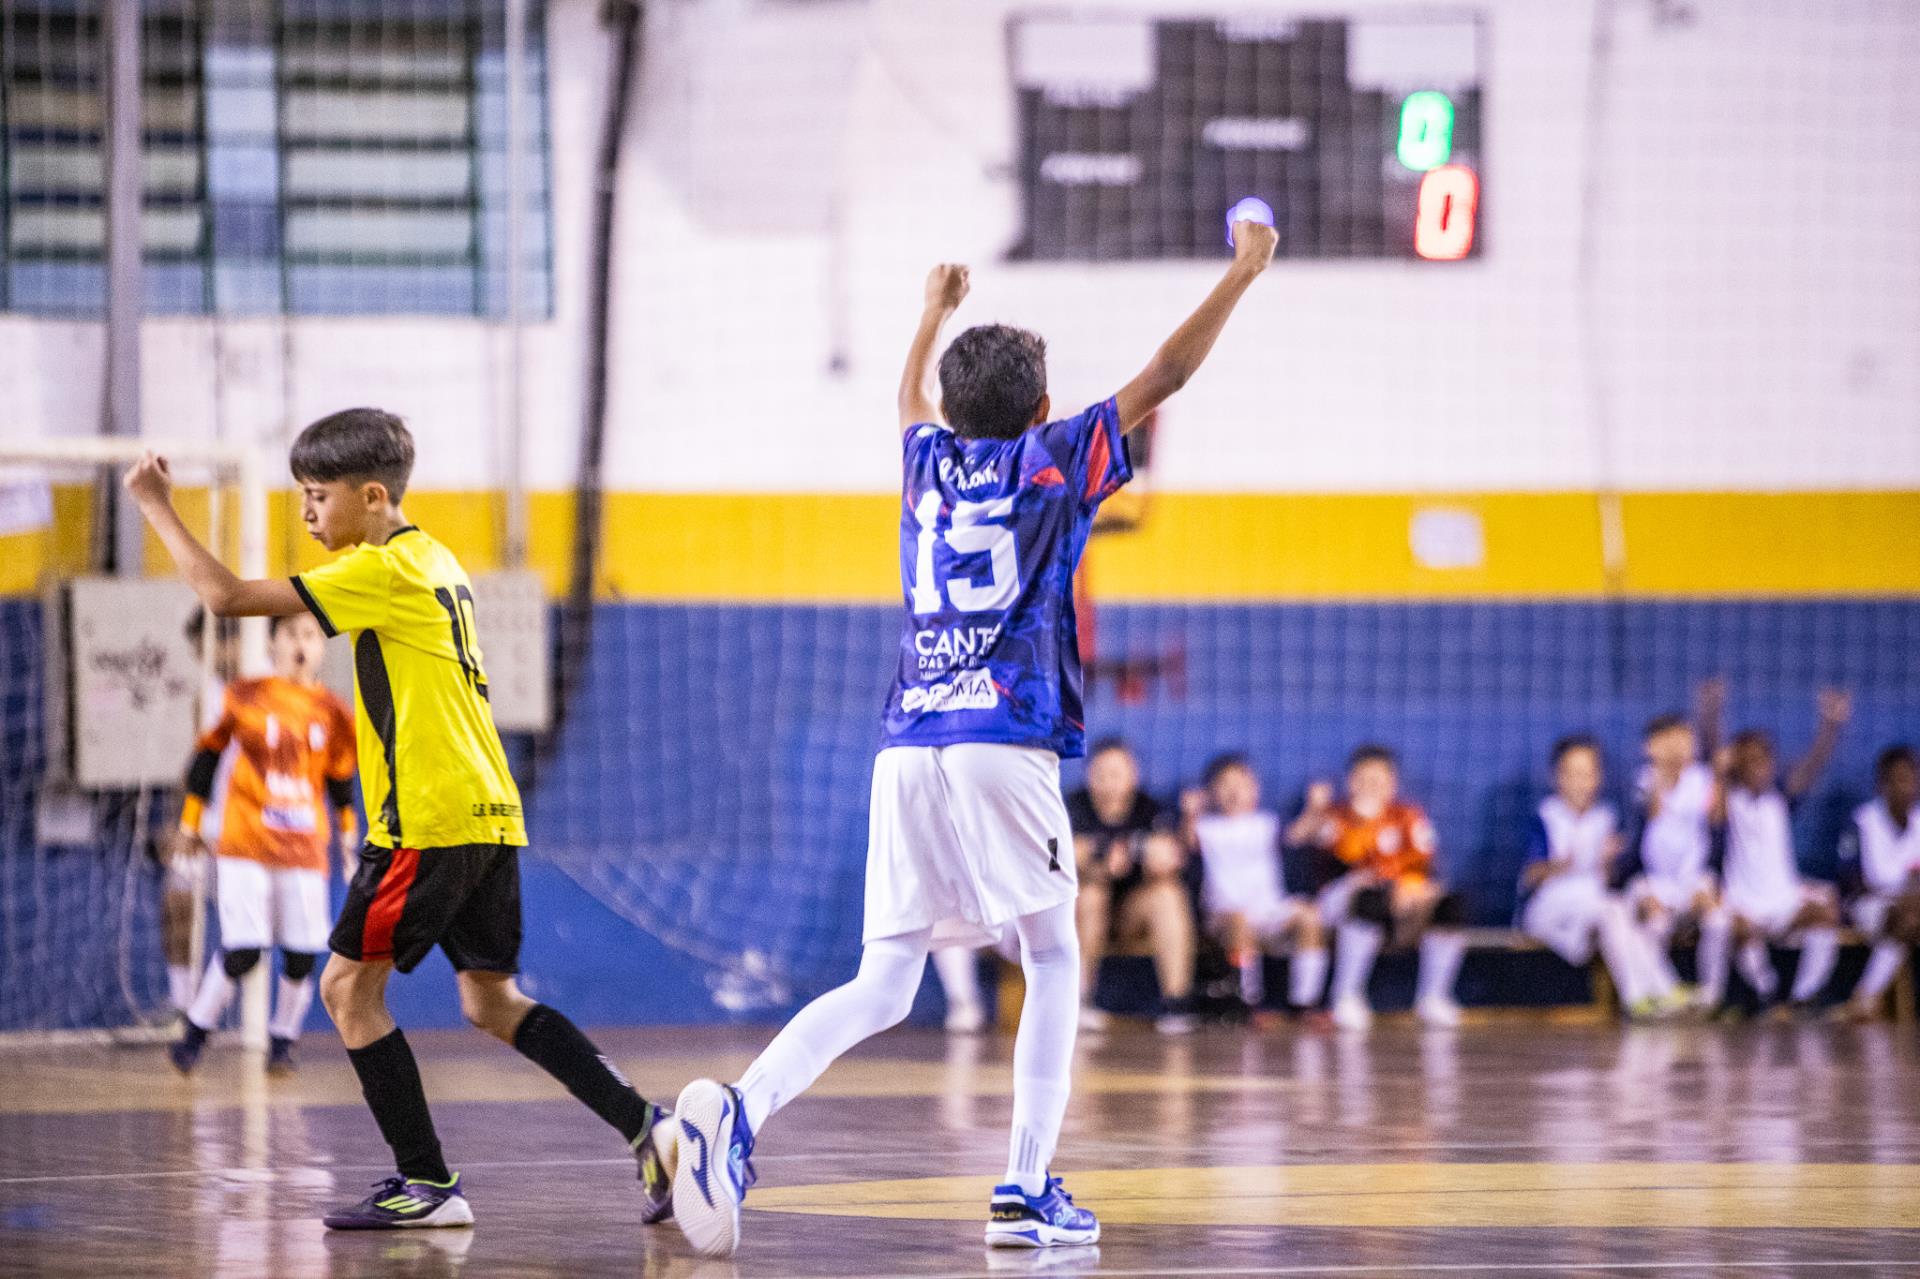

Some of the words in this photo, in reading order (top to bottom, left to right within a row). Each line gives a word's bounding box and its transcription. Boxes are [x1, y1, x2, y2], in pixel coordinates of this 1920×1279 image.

[1398, 91, 1455, 171] 0
[1415, 164, 1480, 260] 0
[911, 490, 1021, 613] 15
